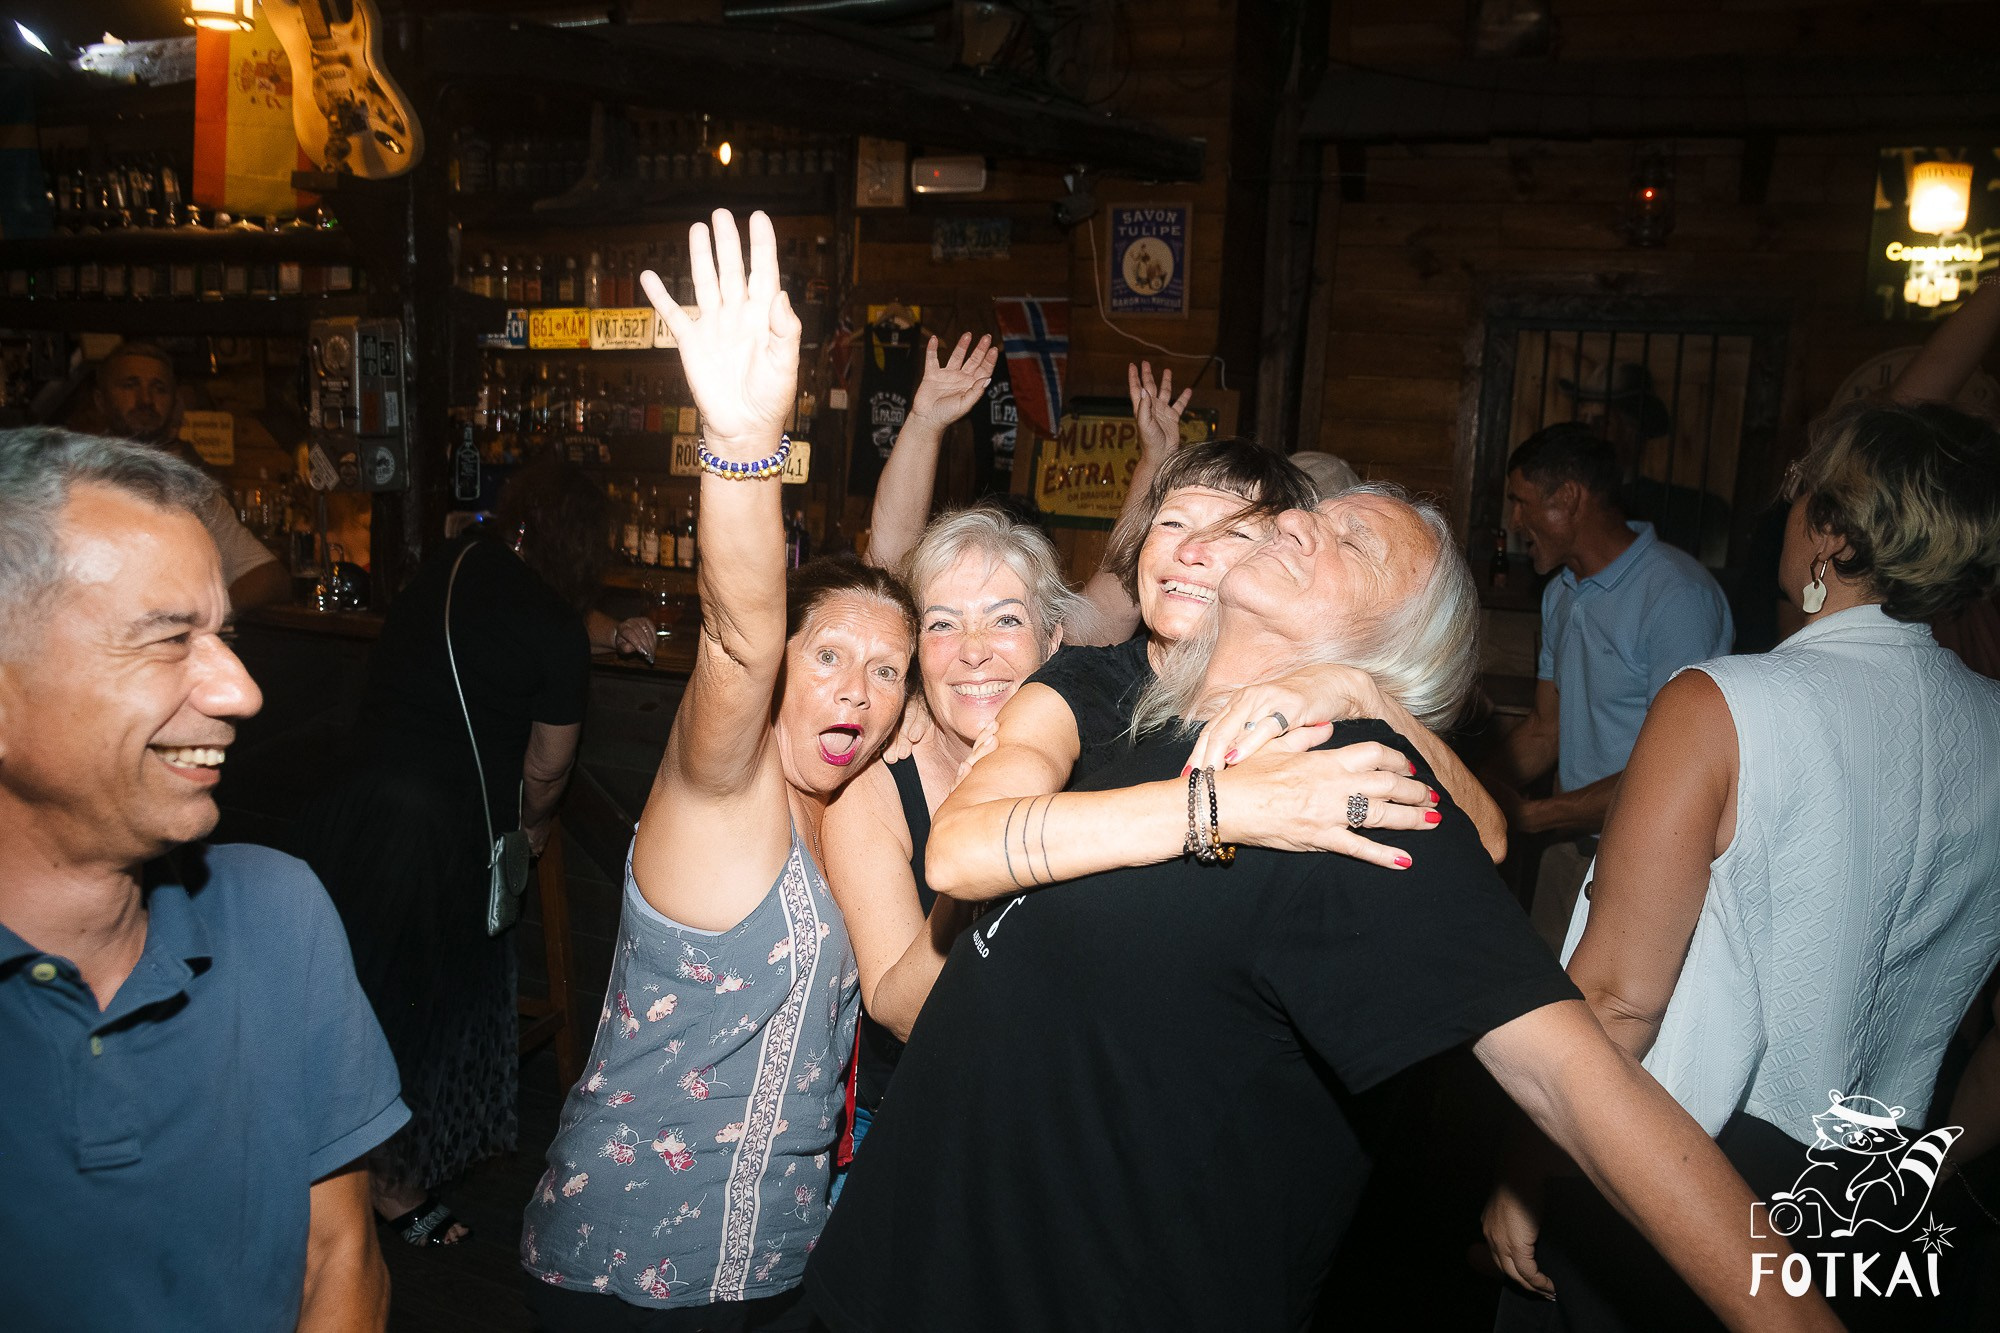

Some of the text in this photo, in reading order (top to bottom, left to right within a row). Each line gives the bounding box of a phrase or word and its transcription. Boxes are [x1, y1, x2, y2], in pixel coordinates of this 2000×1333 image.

[1122, 208, 1178, 225] SAVON
[1118, 225, 1181, 237] TULIPE
[1056, 421, 1141, 460] MURP
[782, 458, 803, 477] 41
[1043, 461, 1116, 495] EXTRA
